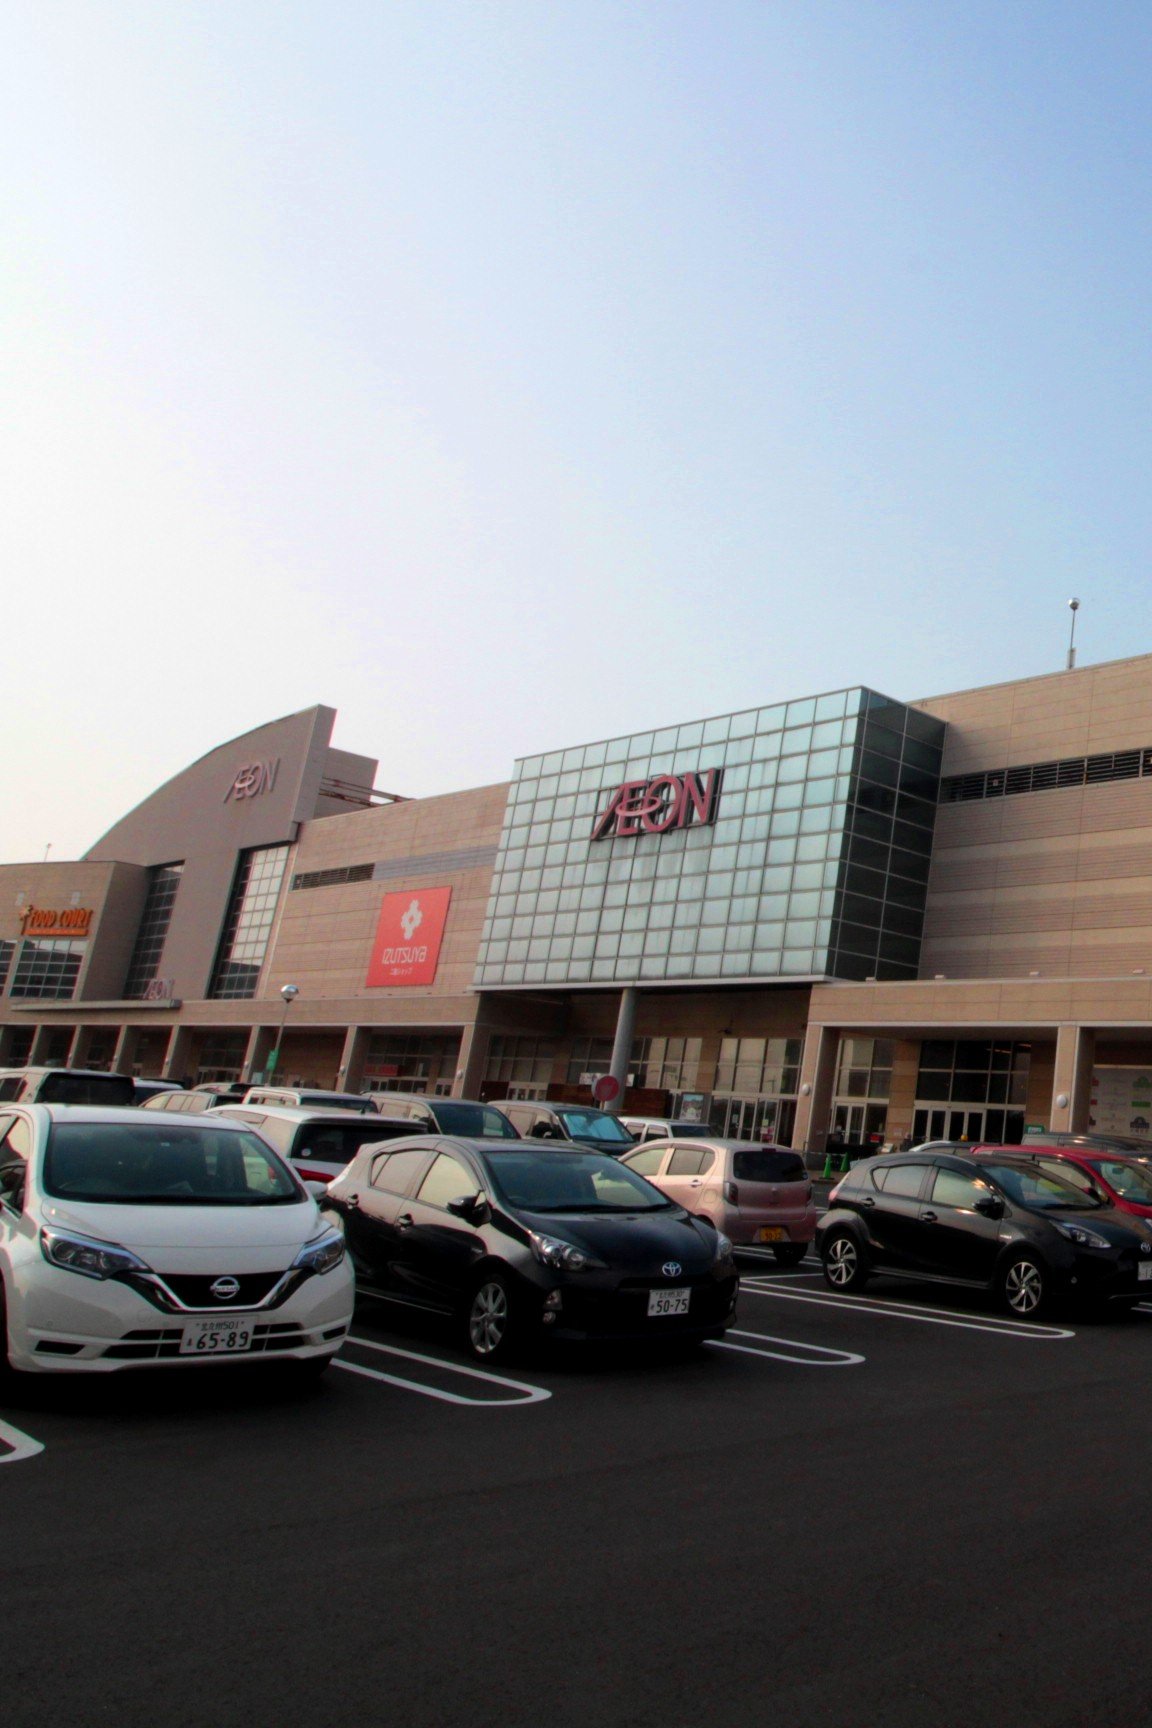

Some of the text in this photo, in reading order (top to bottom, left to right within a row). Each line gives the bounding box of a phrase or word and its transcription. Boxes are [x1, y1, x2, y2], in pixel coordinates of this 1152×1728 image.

[31, 907, 94, 928] FOOD COURT
[657, 1299, 688, 1313] 50-75
[196, 1331, 249, 1350] 65-89
